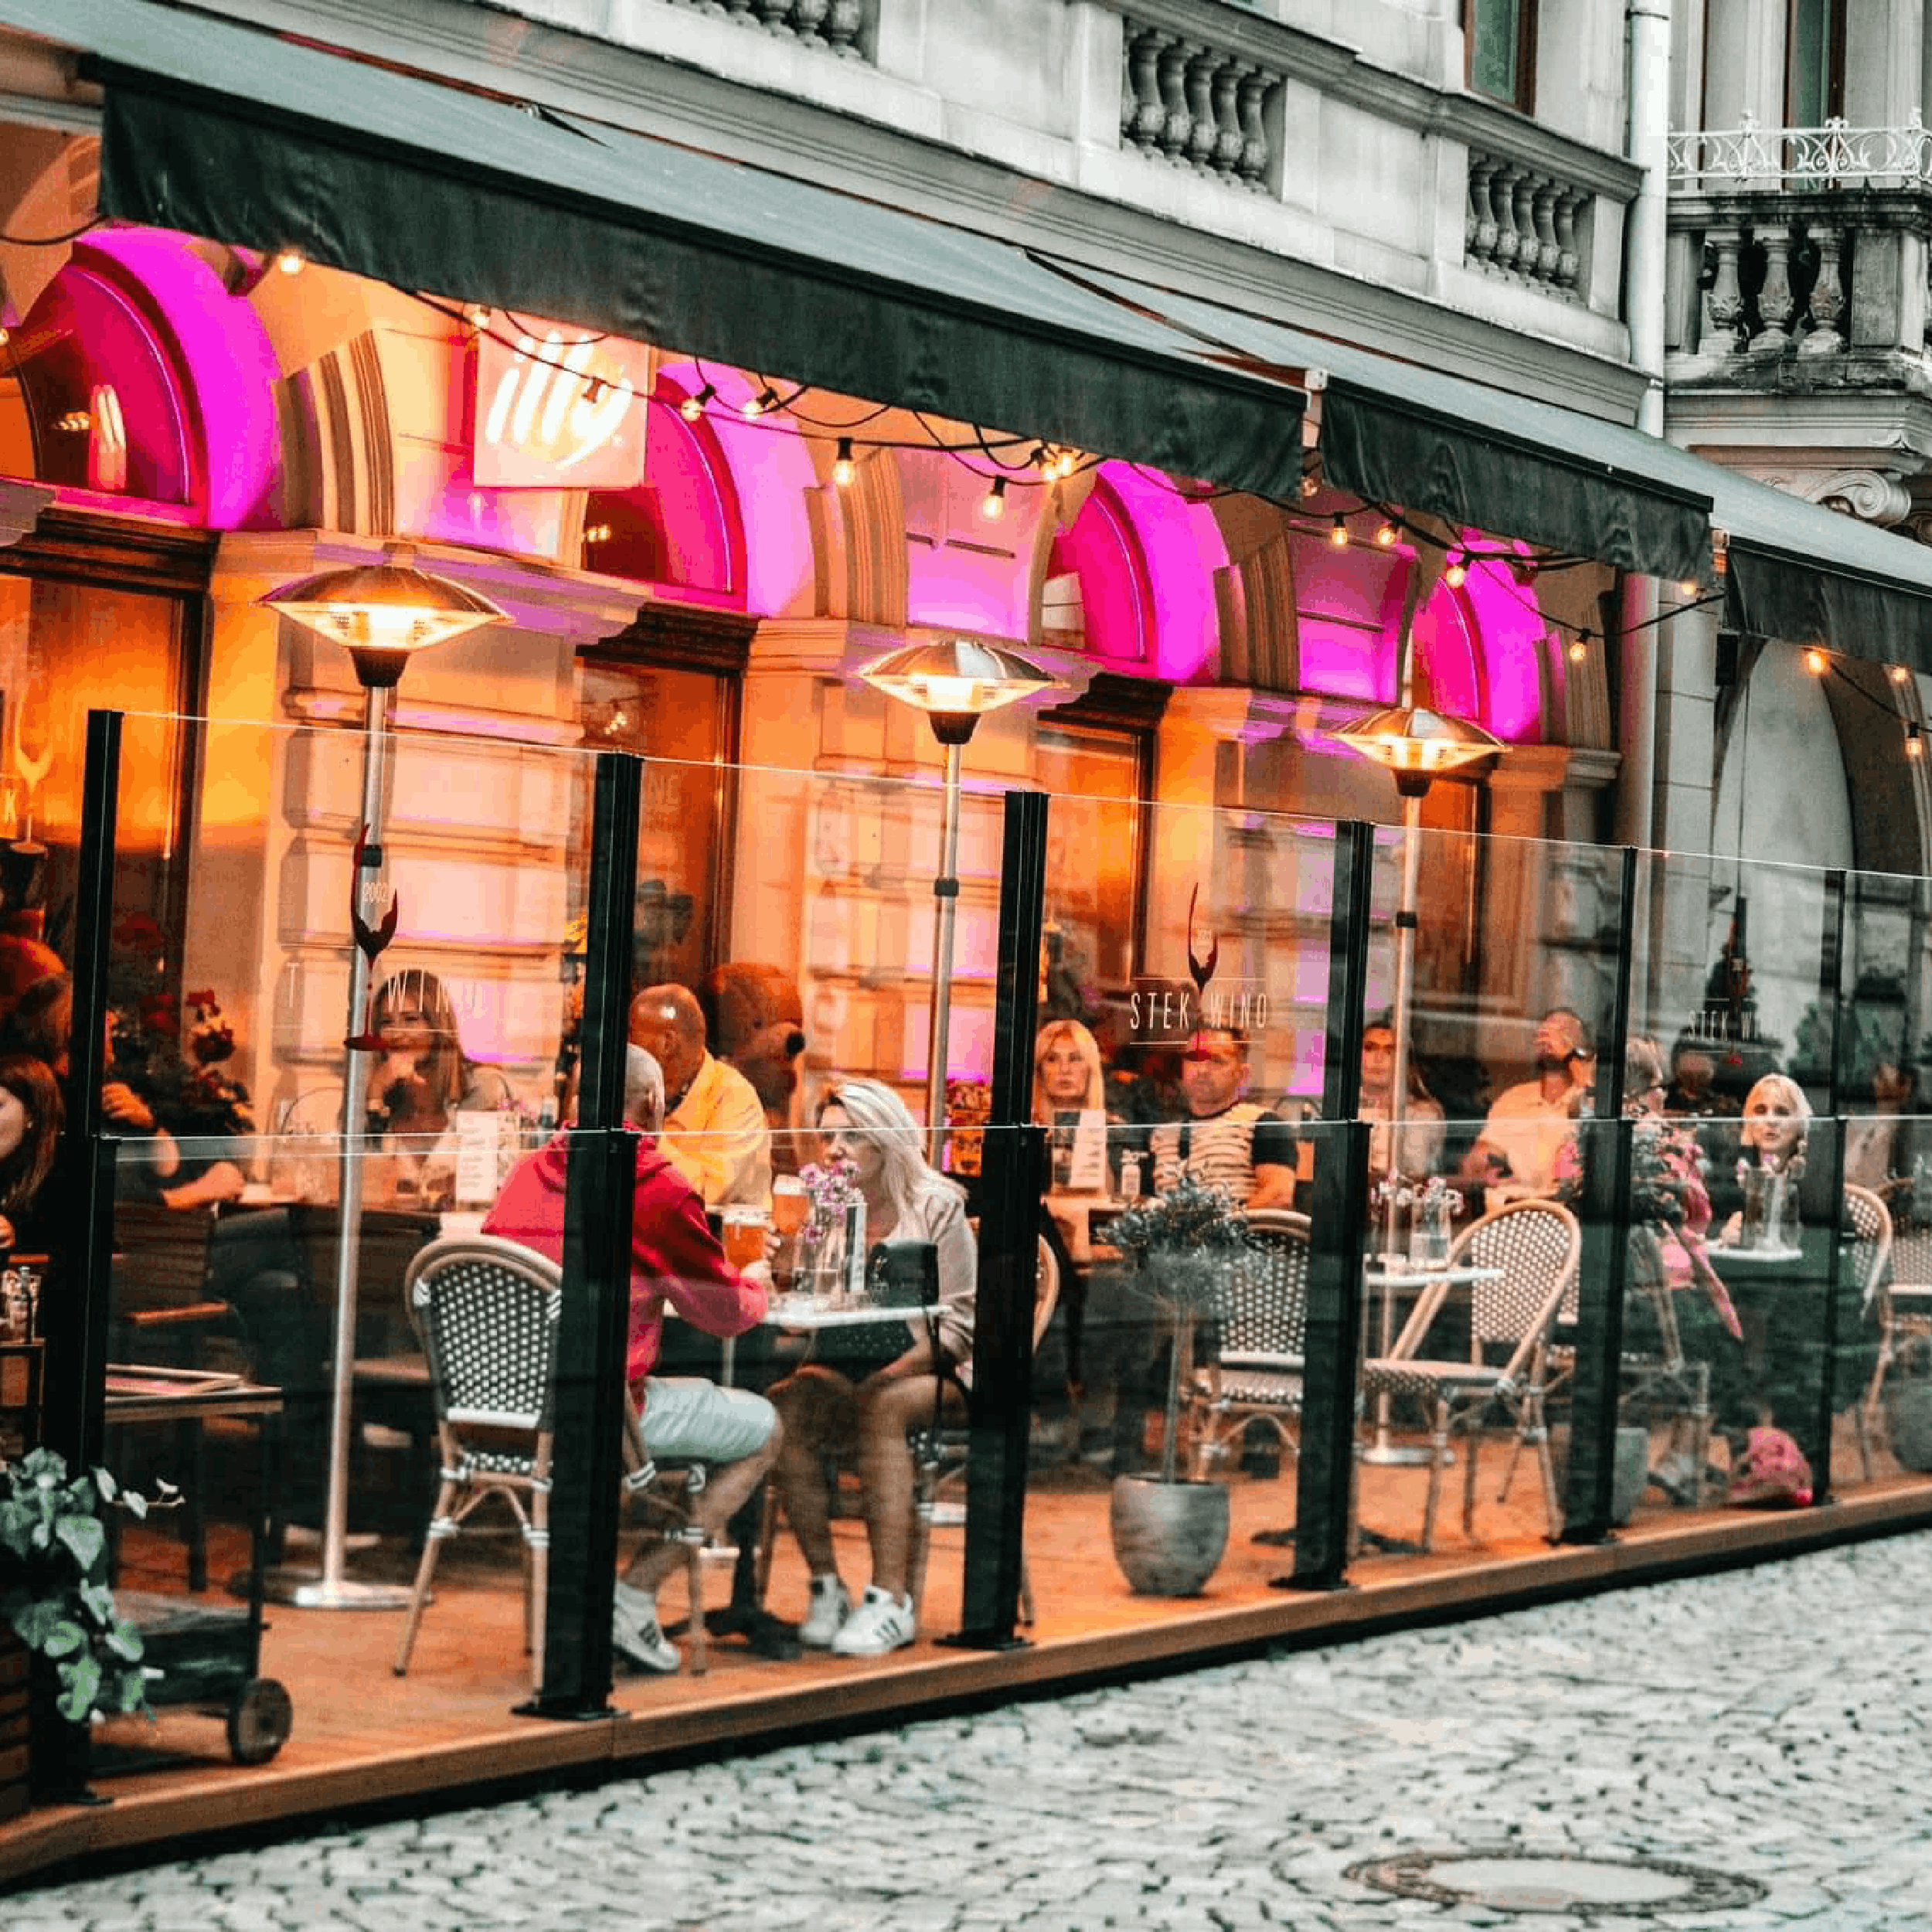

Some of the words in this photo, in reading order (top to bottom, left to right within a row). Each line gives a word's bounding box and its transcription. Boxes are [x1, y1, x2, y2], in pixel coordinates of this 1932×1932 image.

[485, 331, 634, 471] illy
[1129, 992, 1190, 1030] STEK
[1210, 993, 1267, 1030] WINO
